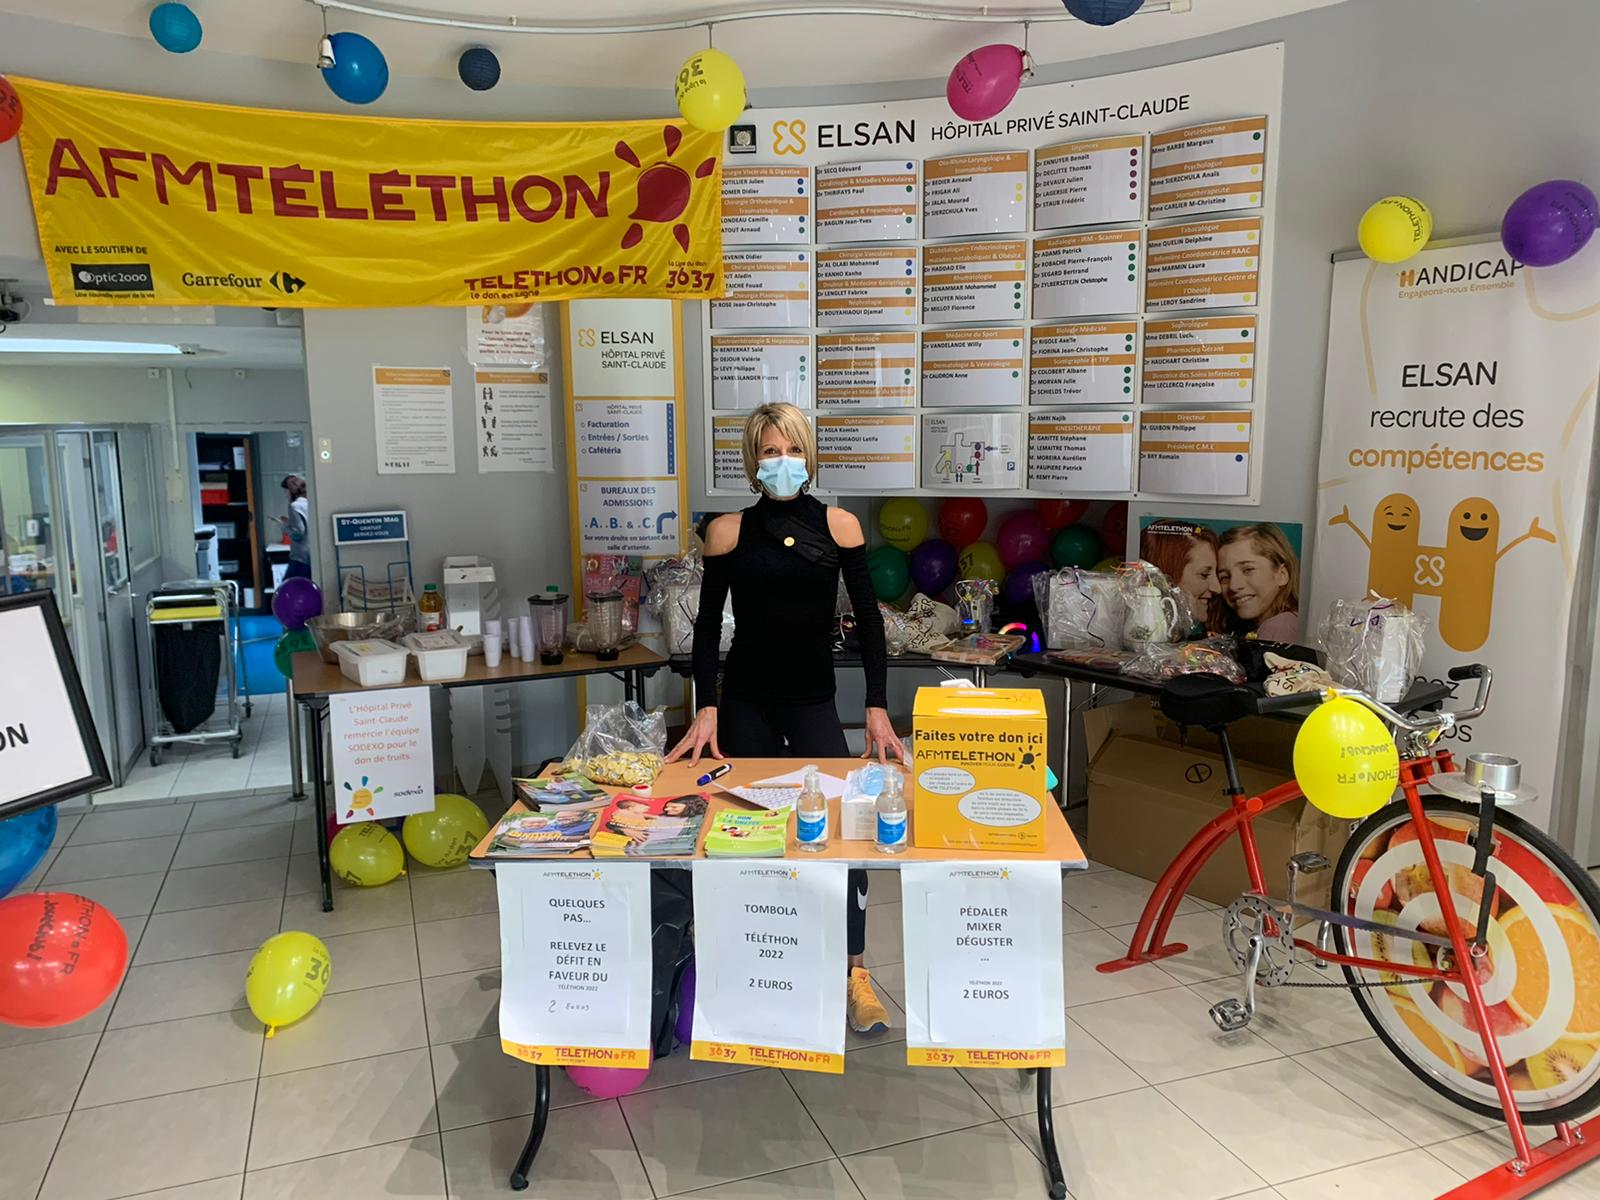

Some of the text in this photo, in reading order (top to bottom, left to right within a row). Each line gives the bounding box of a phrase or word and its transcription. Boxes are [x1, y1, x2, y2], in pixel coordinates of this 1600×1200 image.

[818, 94, 1190, 148] ELSAN HÔPITAL PRIVÉ SAINT-CLAUDE
[54, 245, 148, 254] AVEC LE SOUTIEN DE
[78, 270, 147, 285] Optic2000
[1399, 258, 1525, 288] HANDICAP
[182, 272, 263, 289] Carrefour
[470, 291, 480, 299] le
[482, 291, 499, 299] don
[1398, 280, 1515, 299] Engageons-nous Ensemble
[601, 331, 654, 344] ELSAN
[601, 349, 666, 359] HÔPITAL PRIVÉ
[602, 360, 666, 369] SAINT-CLAUDE
[1401, 361, 1498, 388] ELSAN
[1370, 402, 1524, 428] recrute des
[587, 420, 630, 429] Facturation
[588, 433, 615, 441] Entrées
[622, 433, 649, 441] Sorties
[588, 447, 621, 455] Cafétéria
[1349, 442, 1545, 474] compétences
[601, 486, 656, 494] BUREAUX DES
[602, 499, 654, 507] ADMISSIONS
[626, 520, 634, 528] &
[349, 700, 412, 714] L'Hôpital Privé
[344, 726, 420, 740] remercie l'équipe
[915, 729, 1043, 744] Faites votre don ici
[347, 739, 417, 753] SODEXO pour le
[354, 752, 412, 765] don de fruits.
[393, 785, 424, 798] sodexo
[549, 898, 606, 909] QUELQUES
[744, 903, 798, 917] TOMBOLA
[959, 905, 1008, 917] PÉDALER
[563, 913, 591, 923] PAS...
[966, 922, 1002, 931] MIXER
[744, 932, 798, 946] TÉLÉTHON
[956, 935, 1013, 947] DÉGUSTER
[550, 942, 607, 952] RELEVEZ LE
[556, 954, 602, 966] DÉFIT EN
[759, 949, 784, 959] 2022
[549, 971, 608, 982] FAVEUR DU
[748, 978, 793, 991] 2 EUROS
[963, 989, 1010, 1000] 2 EUROS
[548, 999, 557, 1013] 2
